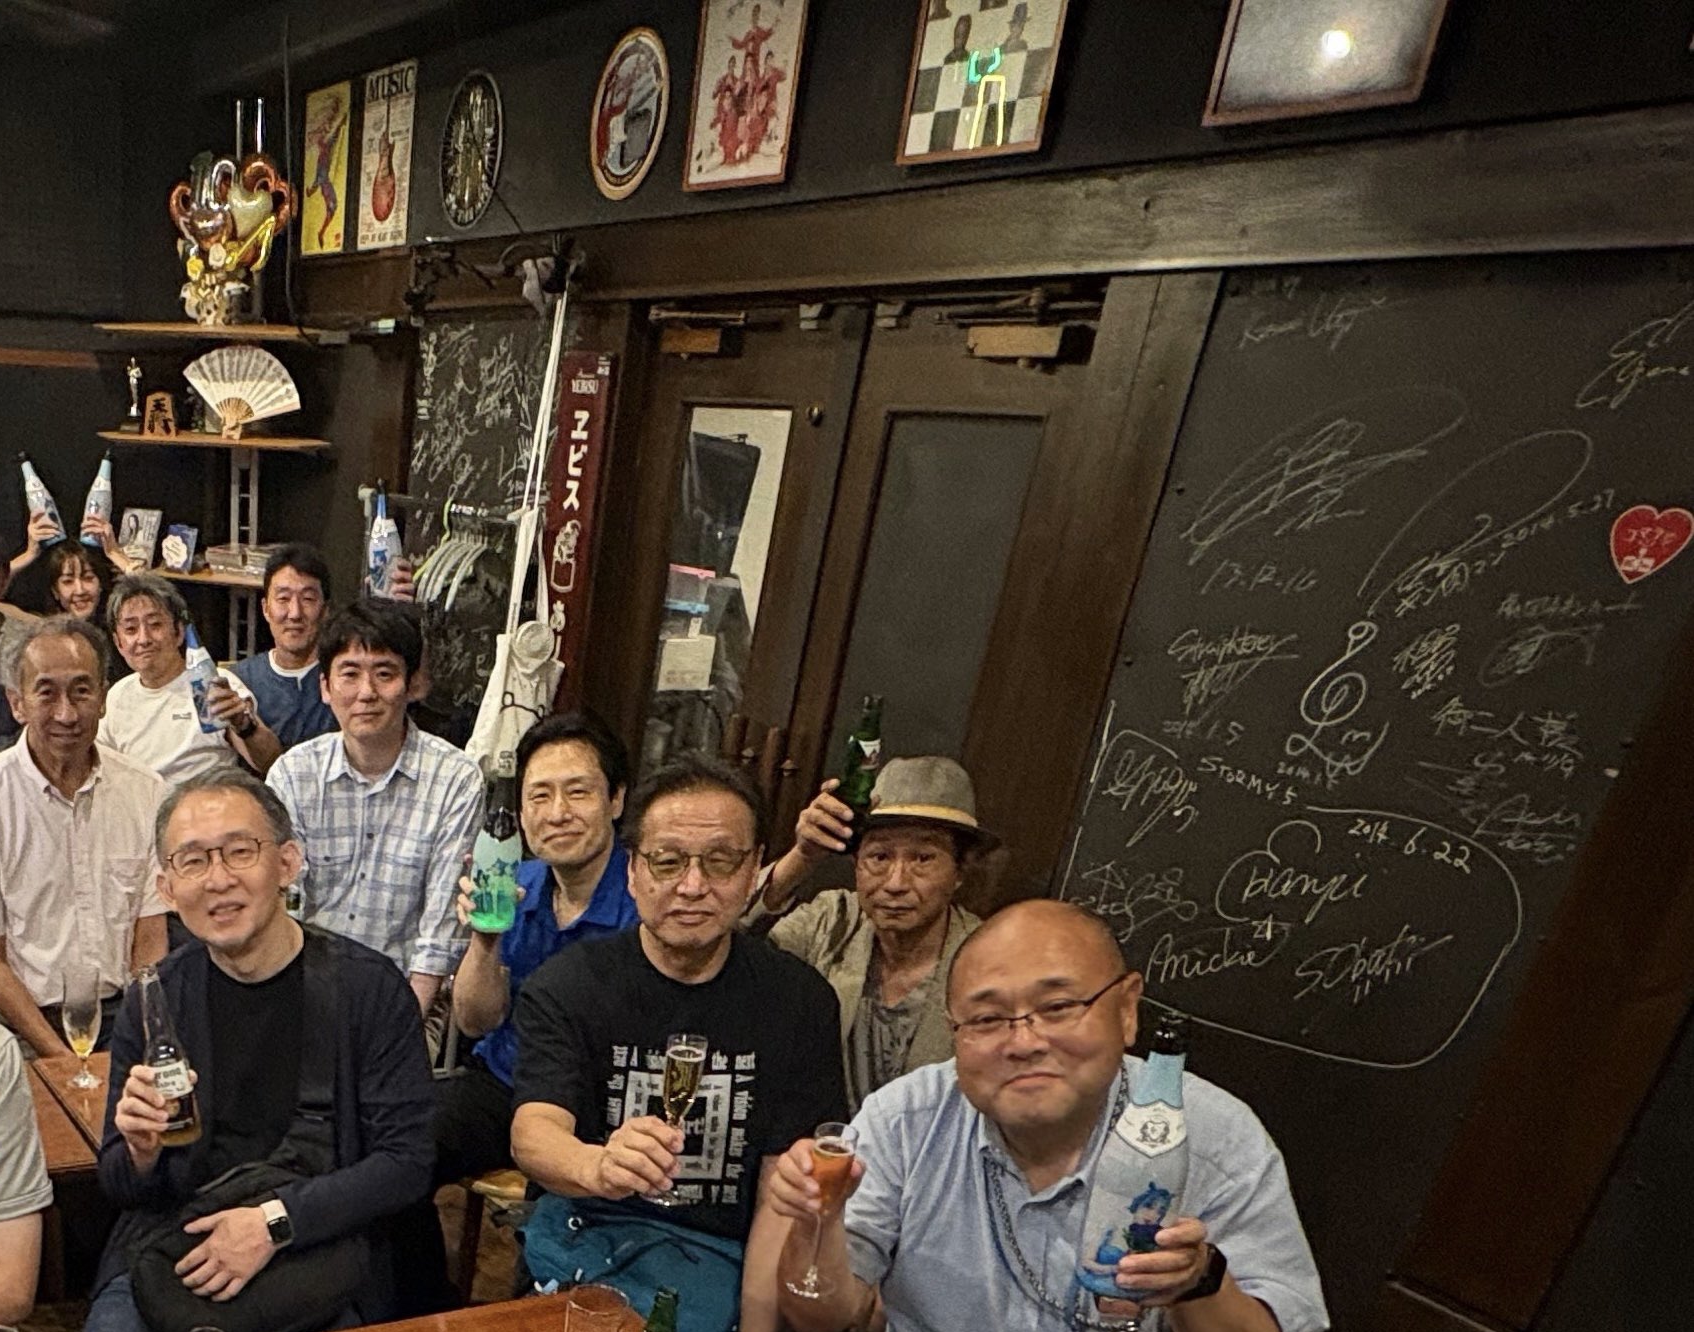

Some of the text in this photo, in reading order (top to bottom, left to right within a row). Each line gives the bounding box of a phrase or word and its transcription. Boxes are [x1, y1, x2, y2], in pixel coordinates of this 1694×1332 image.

[368, 65, 416, 100] MUSIC
[562, 410, 590, 511] ヱビス
[711, 1051, 728, 1071] the
[732, 1090, 754, 1120] vision
